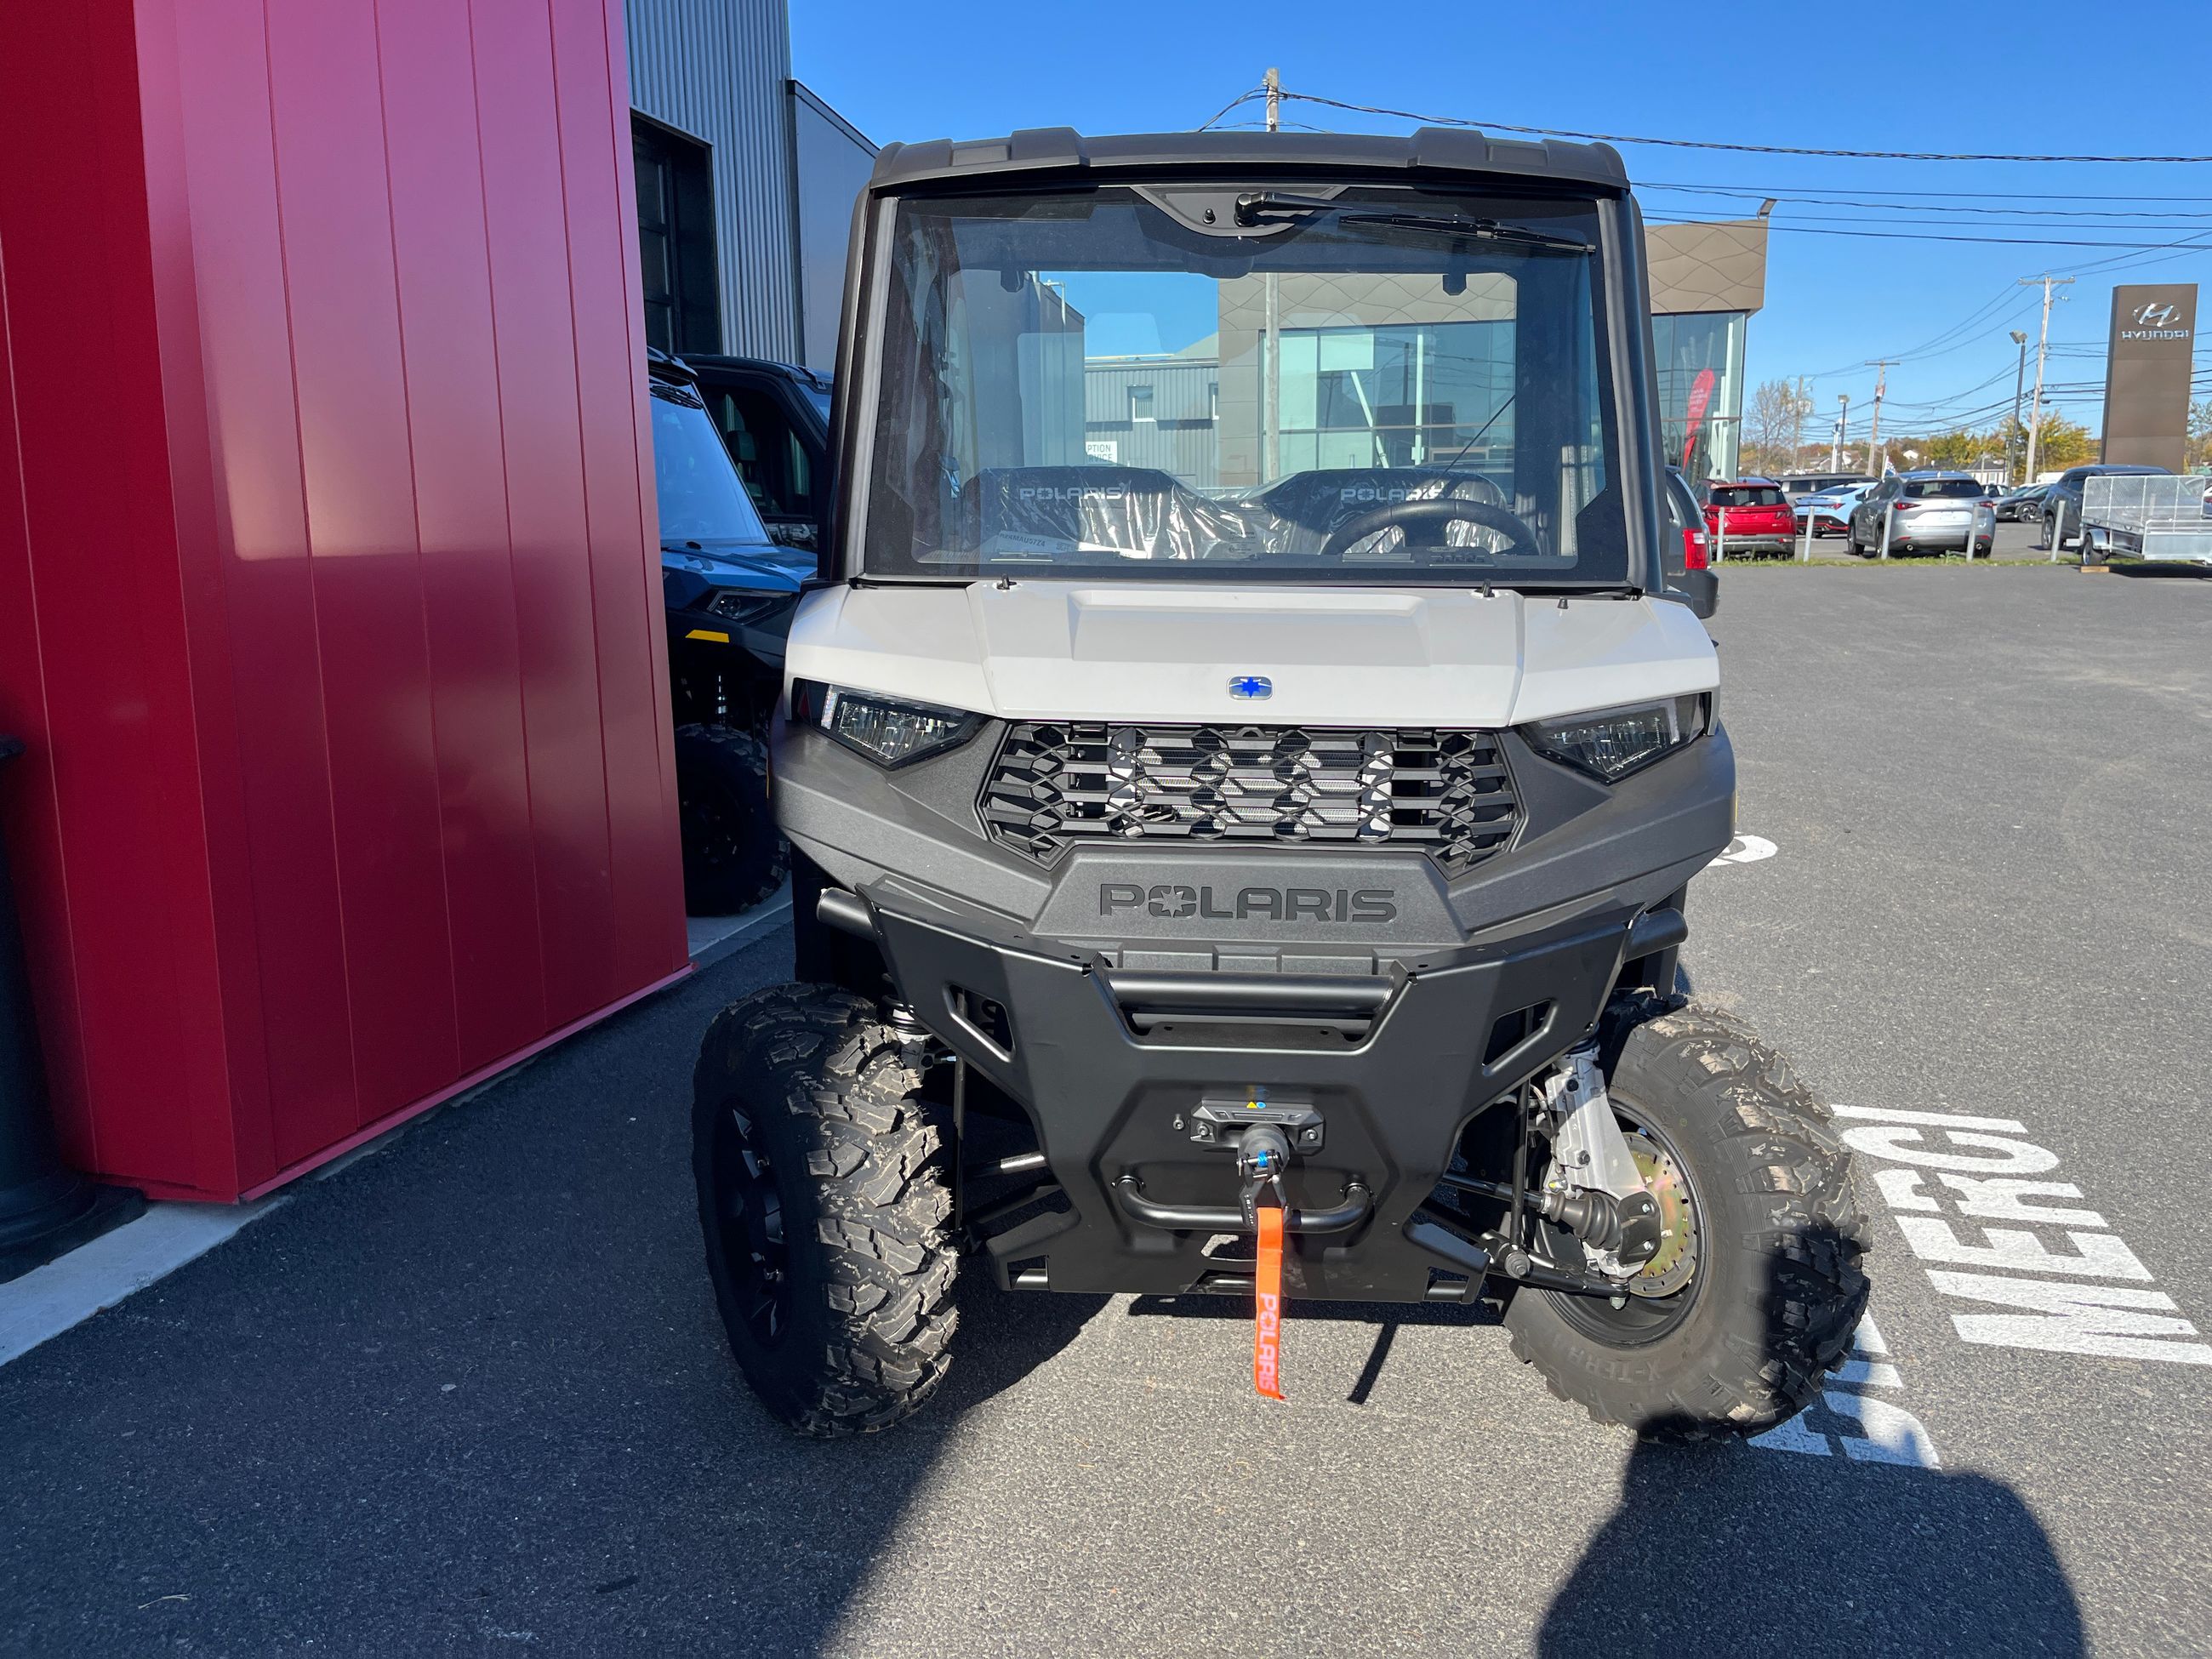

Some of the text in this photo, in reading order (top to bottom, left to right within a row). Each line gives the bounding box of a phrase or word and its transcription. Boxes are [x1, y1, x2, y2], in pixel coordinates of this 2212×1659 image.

[2122, 329, 2189, 340] HYUNDAI
[1019, 487, 1123, 500] POLARIS
[1340, 488, 1445, 501] POLARIS
[1100, 883, 1397, 923] POLARIS
[1831, 1103, 2212, 1365] MERCI
[1257, 1292, 1278, 1393] POLARIS
